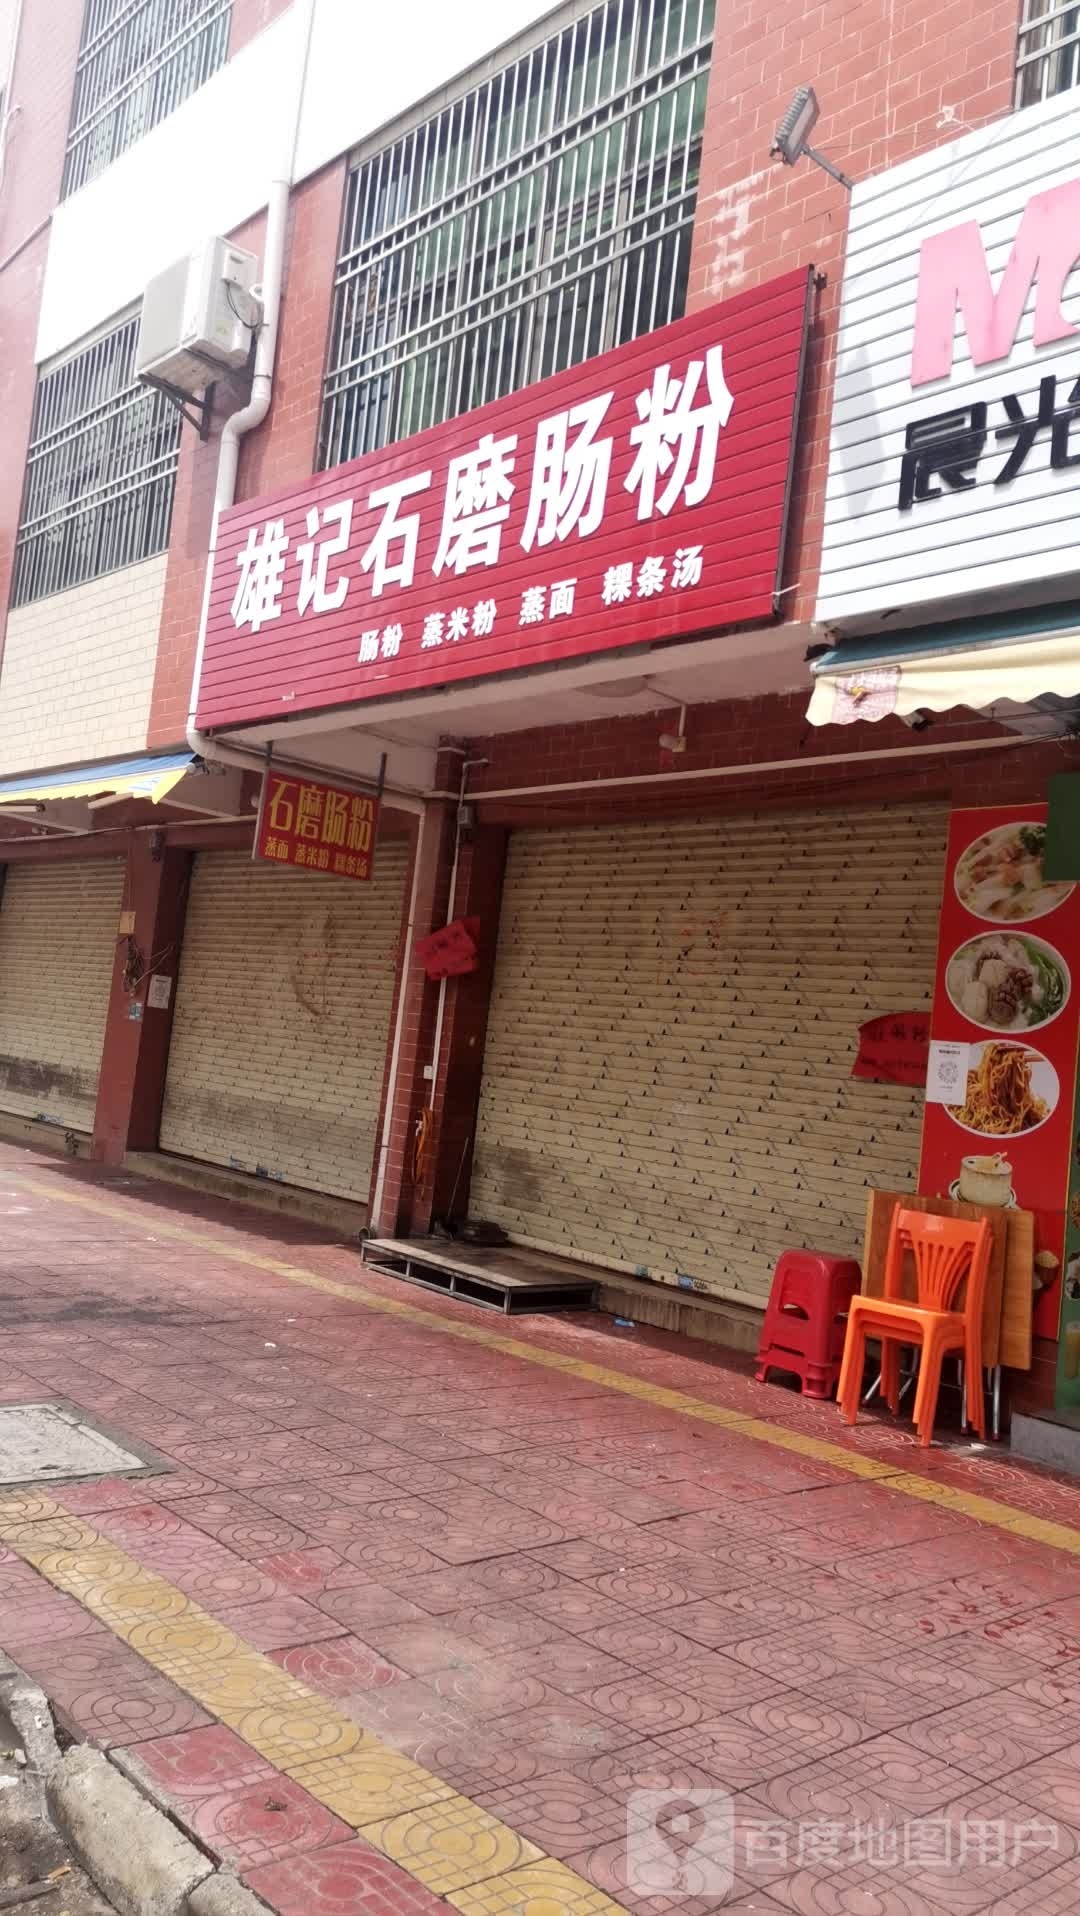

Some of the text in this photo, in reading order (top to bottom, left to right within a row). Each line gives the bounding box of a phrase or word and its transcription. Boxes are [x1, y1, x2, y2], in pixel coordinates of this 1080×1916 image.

[229, 345, 735, 633] 雄记石磨肠粉
[357, 545, 704, 664] 肠粉 蒸米粉 蒸面 粿条汤
[264, 836, 289, 859] 蒸面
[295, 843, 330, 869] 蒸米粉
[269, 778, 374, 853] 石磨肠粉
